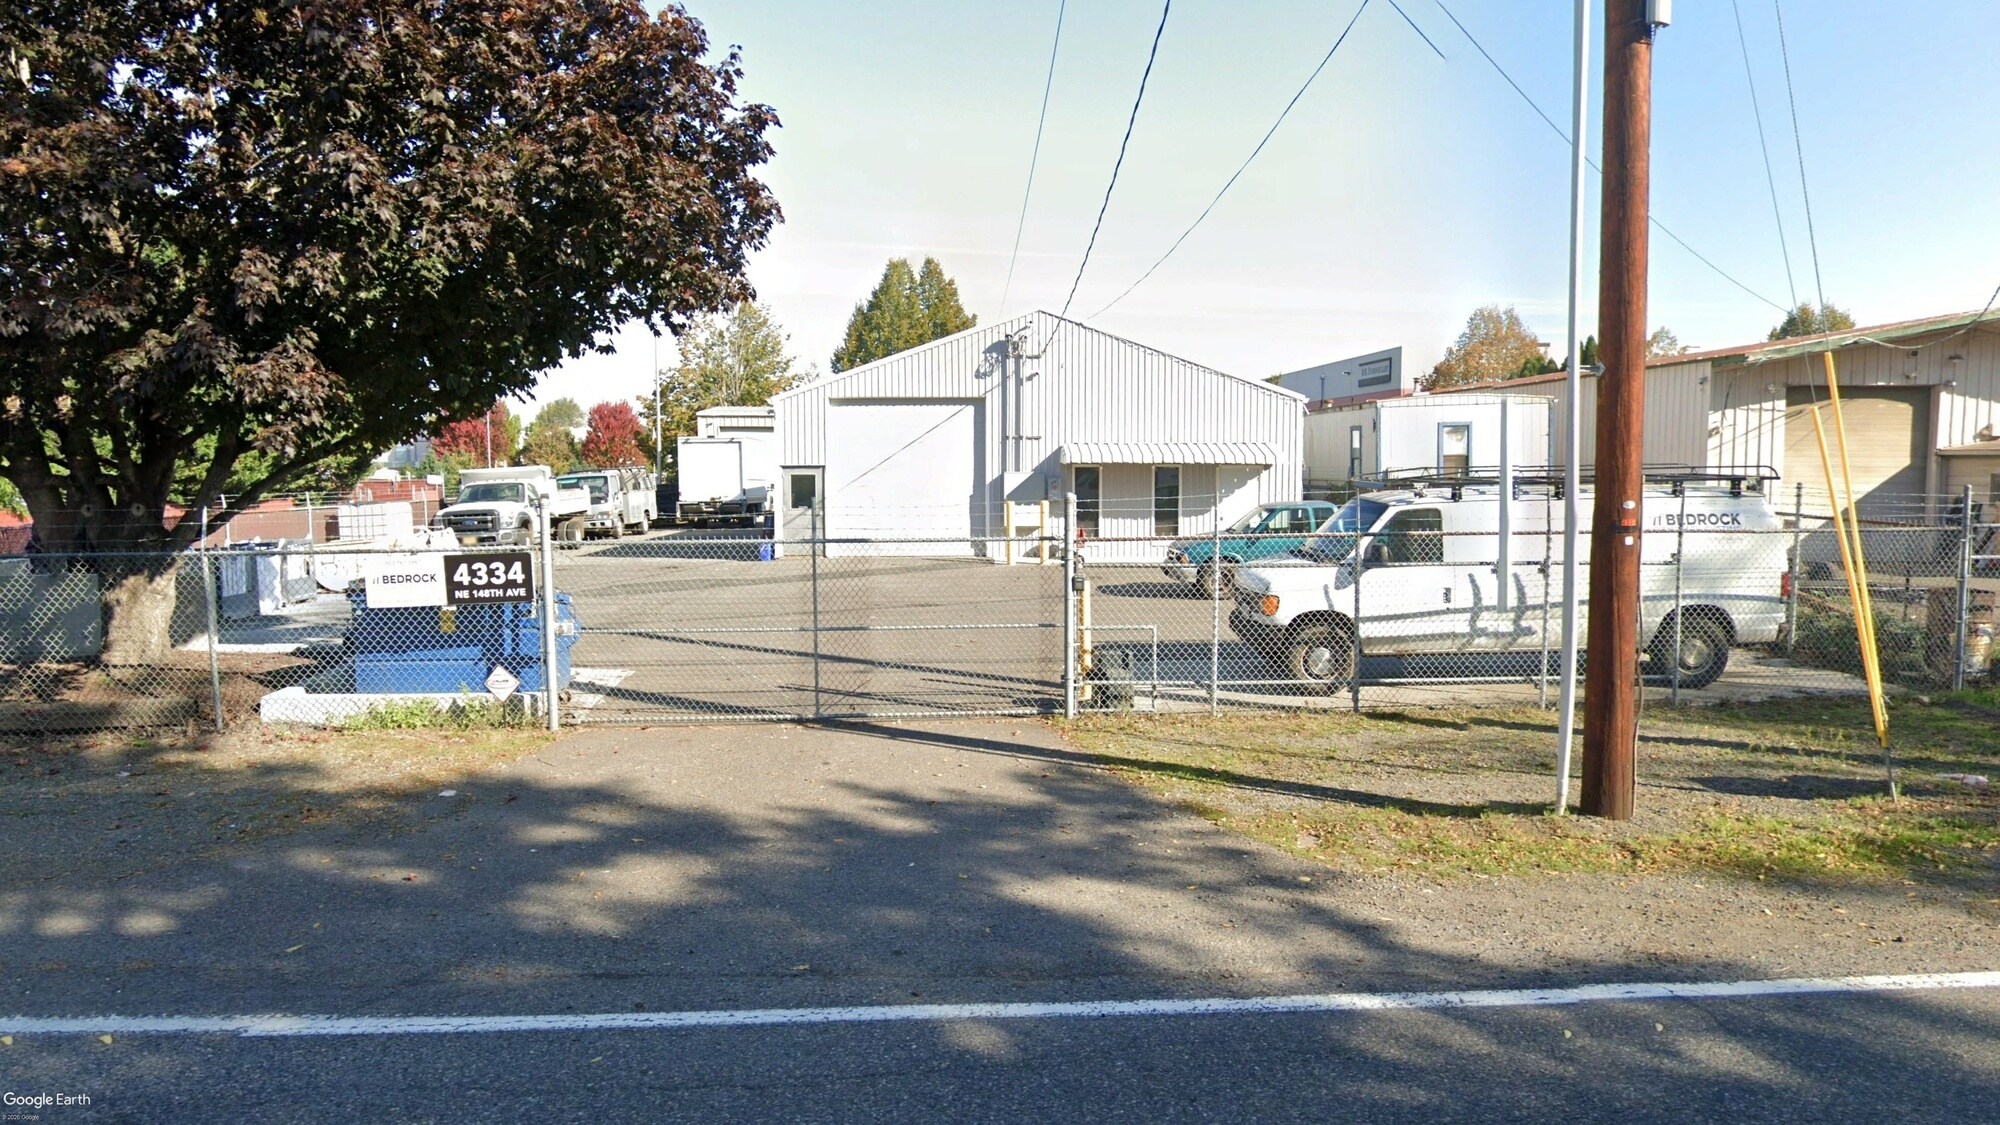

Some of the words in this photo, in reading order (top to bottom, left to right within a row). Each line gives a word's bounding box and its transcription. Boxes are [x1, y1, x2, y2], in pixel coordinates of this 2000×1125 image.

[382, 573, 437, 584] BEDROCK
[453, 561, 525, 585] 4334
[455, 590, 470, 599] NE
[472, 589, 504, 598] 148TH
[506, 588, 526, 597] AVE
